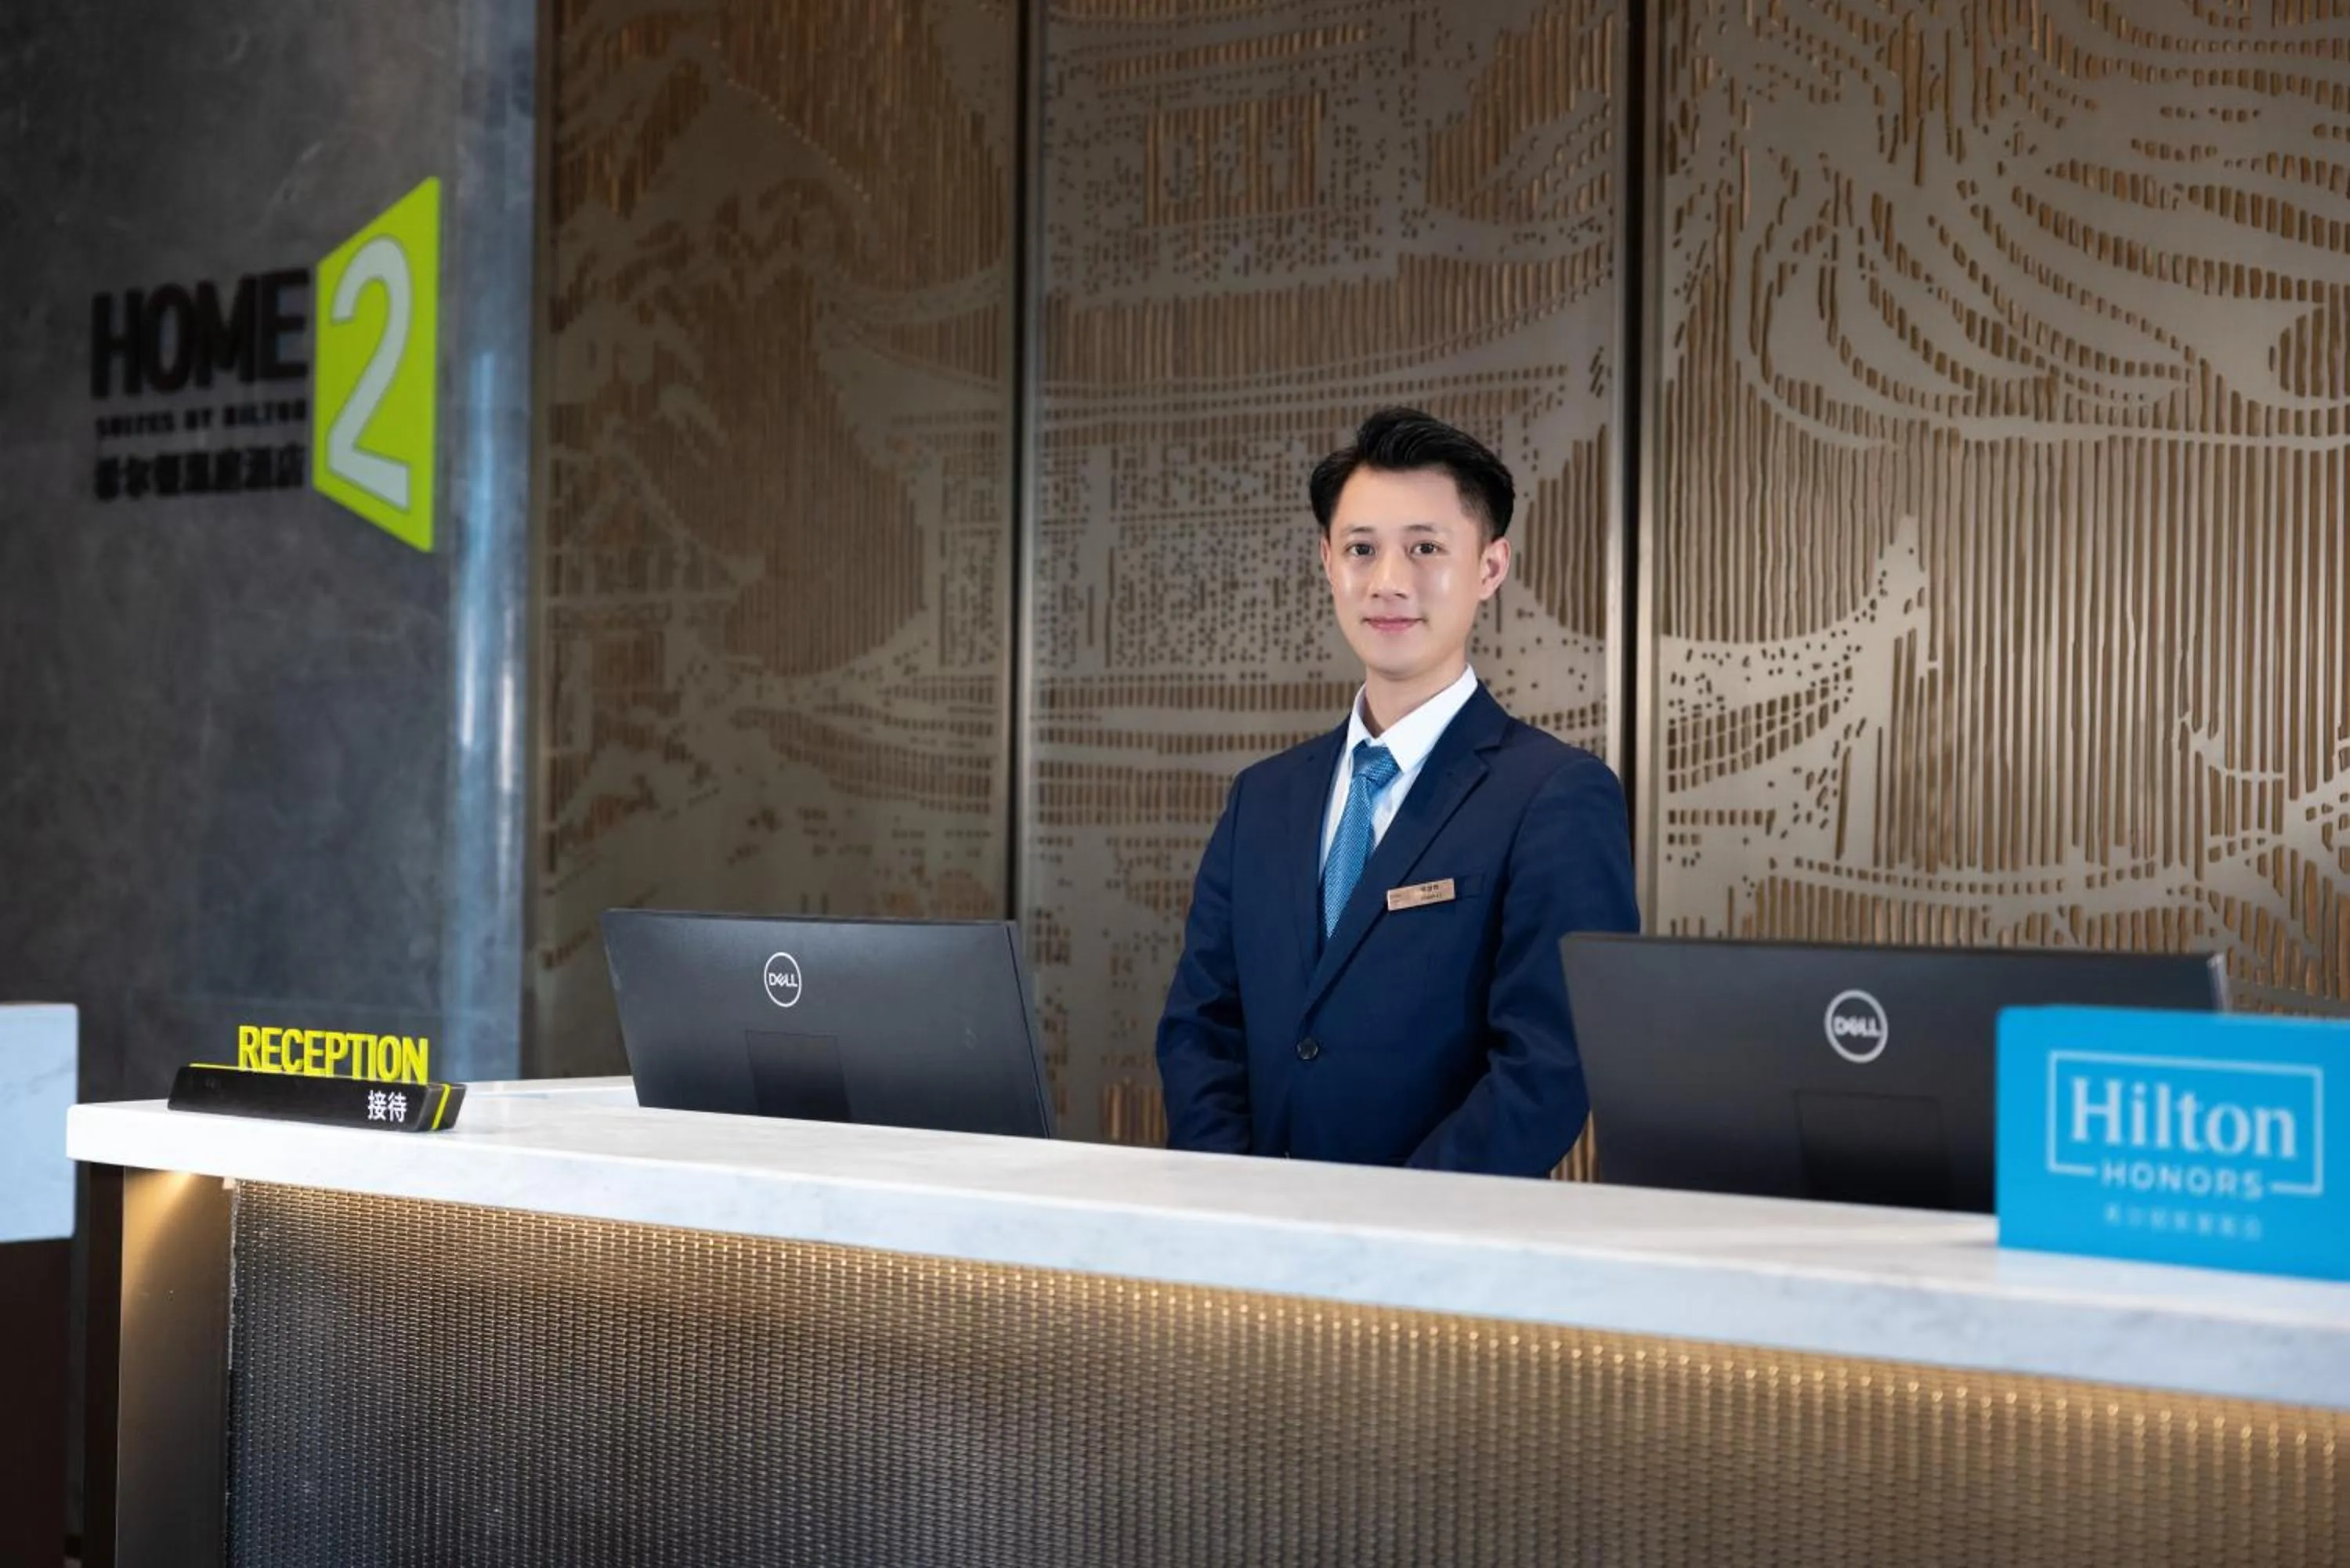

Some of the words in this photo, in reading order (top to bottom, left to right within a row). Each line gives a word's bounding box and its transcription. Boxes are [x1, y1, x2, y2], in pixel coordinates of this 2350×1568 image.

[91, 268, 309, 399] HOME
[328, 233, 411, 514] 2
[768, 973, 798, 987] DELL
[1834, 1015, 1882, 1038] DELL
[238, 1025, 428, 1084] RECEPTION
[367, 1089, 407, 1122] 接待
[2071, 1076, 2297, 1158] Hilton
[2102, 1159, 2264, 1201] HONORS
